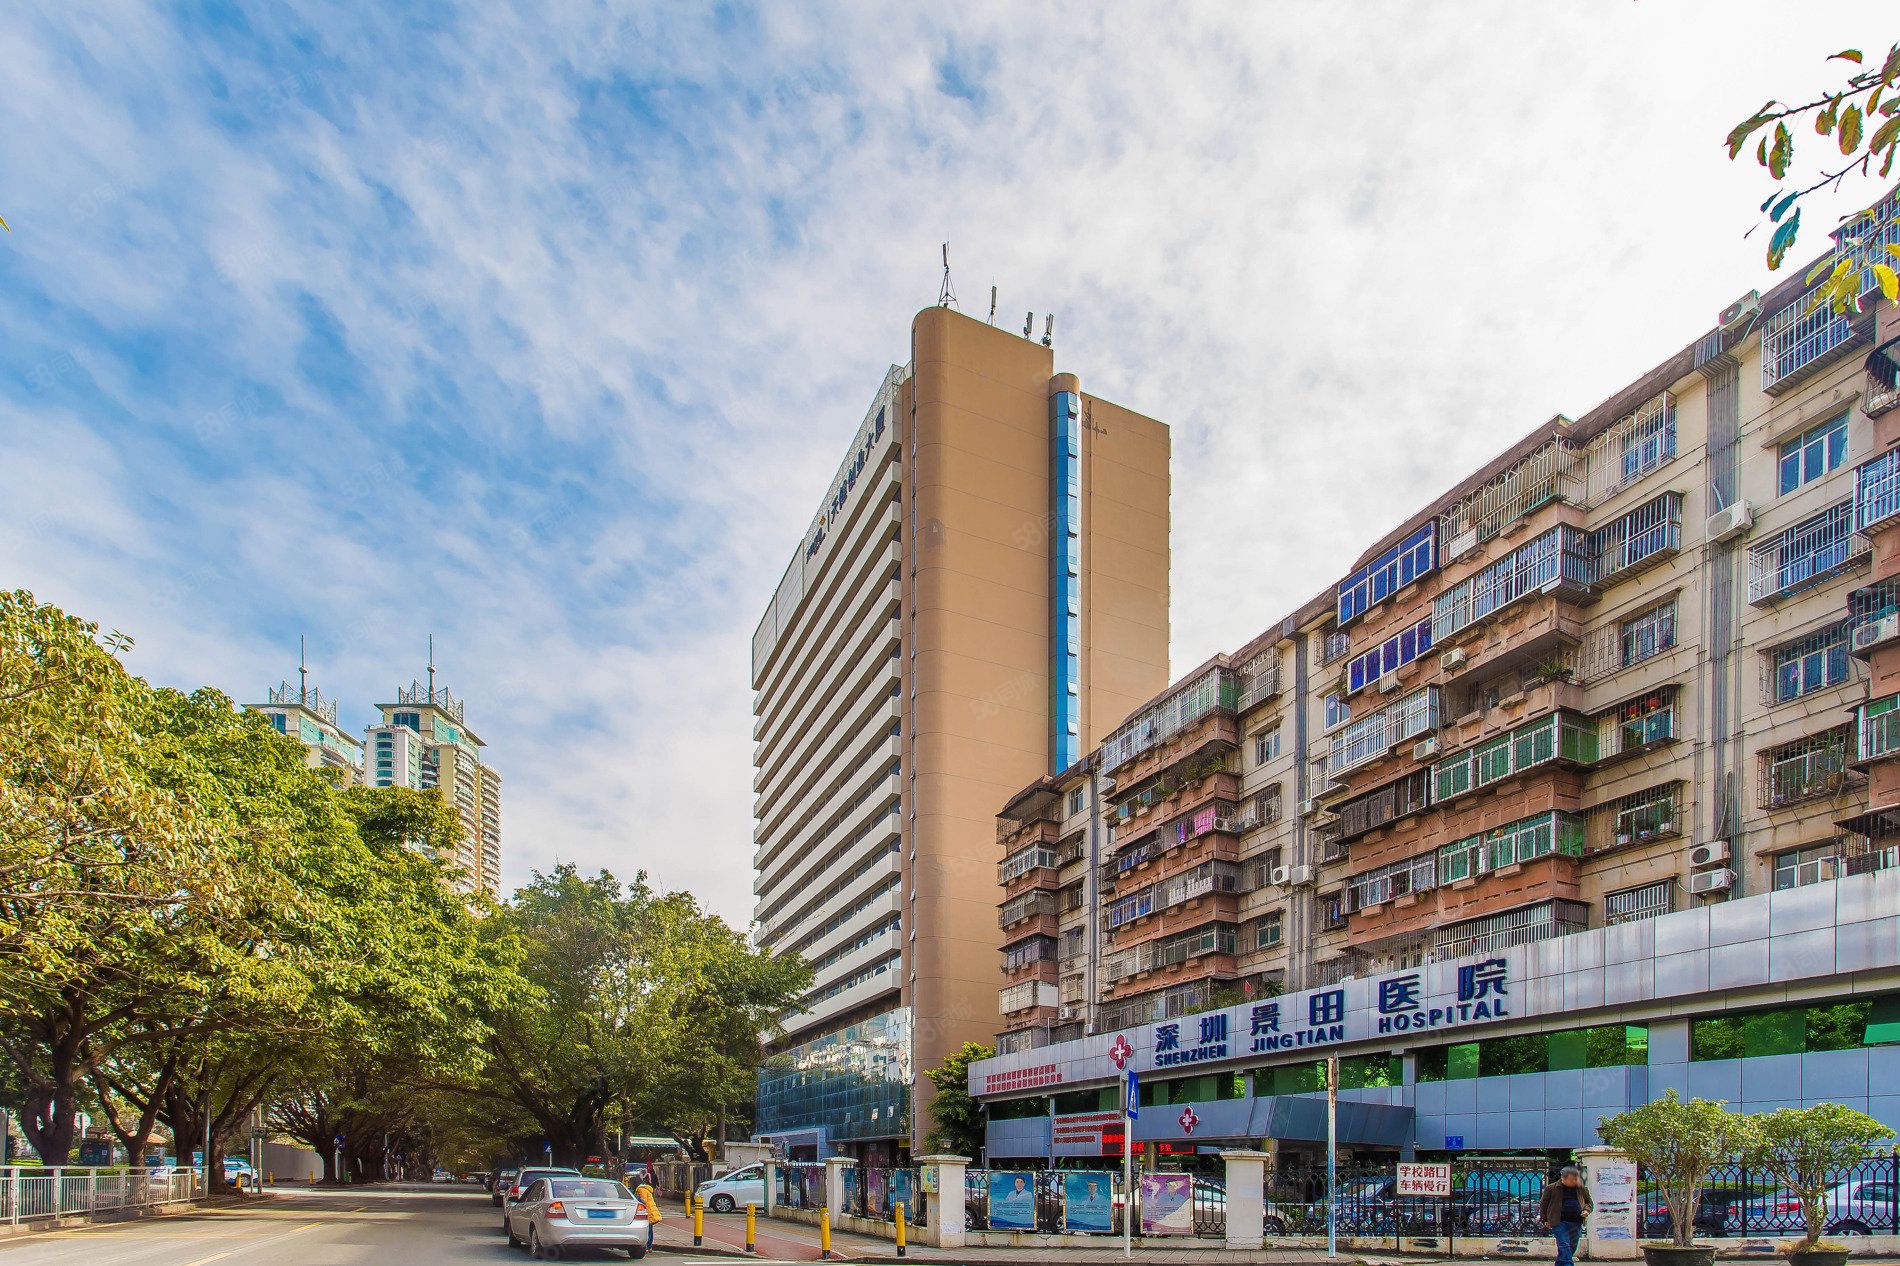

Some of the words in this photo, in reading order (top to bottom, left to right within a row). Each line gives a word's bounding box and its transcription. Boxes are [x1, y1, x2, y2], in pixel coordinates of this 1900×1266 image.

[1155, 1044, 1227, 1067] SHENZHEN
[1250, 1025, 1344, 1053] JINGTIAN
[1378, 998, 1508, 1034] HOSPITAL
[1399, 1165, 1447, 1179] 学校路口
[1399, 1179, 1448, 1192] 车辆慢行
